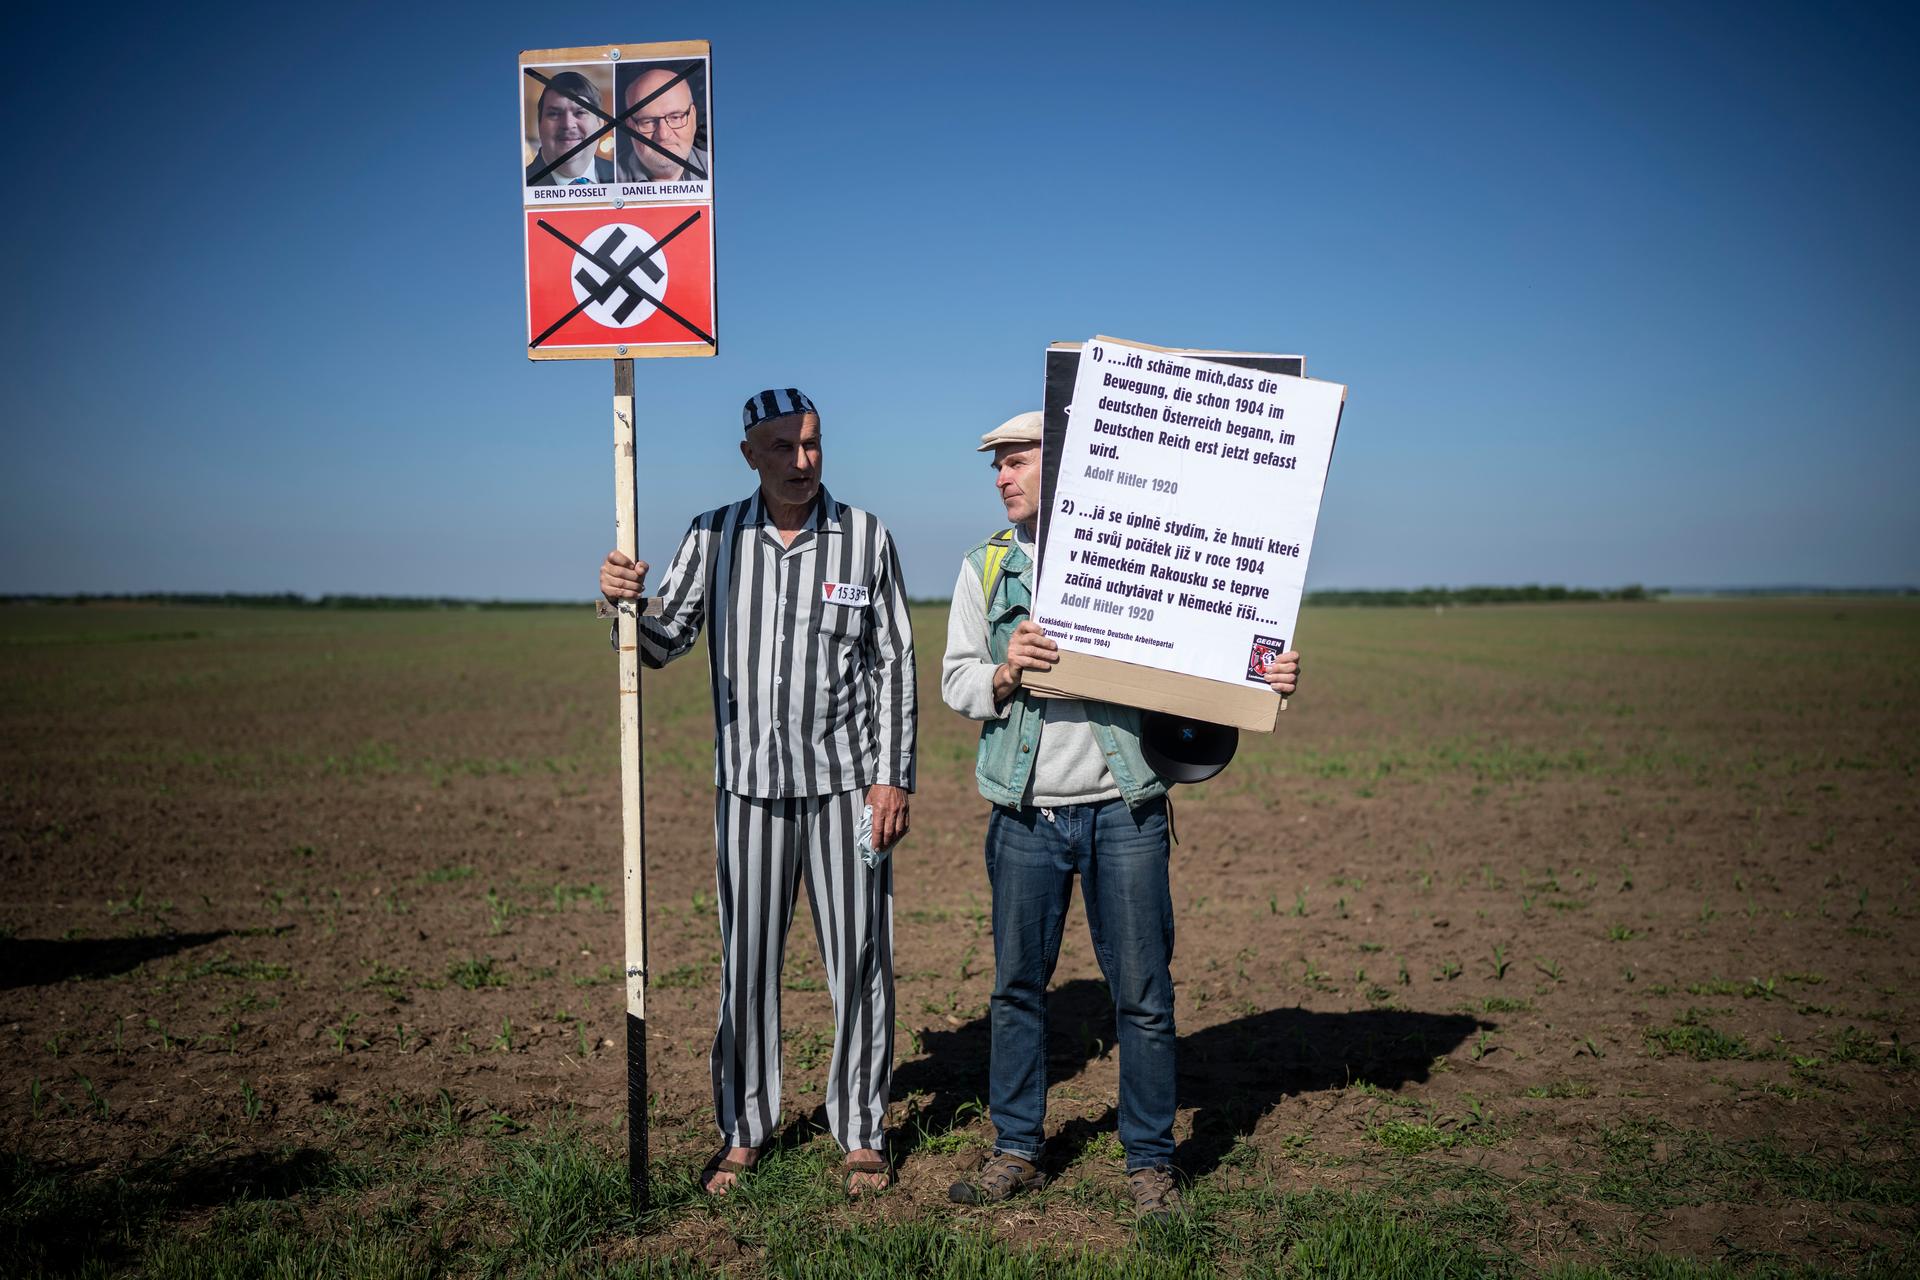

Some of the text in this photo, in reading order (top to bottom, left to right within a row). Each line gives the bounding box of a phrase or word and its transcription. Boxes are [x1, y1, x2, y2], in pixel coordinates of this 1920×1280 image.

[534, 187, 607, 199] BERND POSSELT
[622, 184, 704, 195] DANIEL HERMAN
[1092, 346, 1104, 363] 1)
[1146, 359, 1191, 379] schäme
[1258, 378, 1278, 395] die
[1103, 372, 1285, 420] Bewegung, die schon 1904 im
[1093, 418, 1297, 470] Deutschen Reich erst jetzt gefasst
[1098, 396, 1295, 446] deutschen Österreich begann, im
[1089, 442, 1119, 460] wird.
[1084, 465, 1178, 495] Adolf Hitler 1920
[1060, 499, 1075, 516] 2)
[1108, 511, 1123, 524] se
[1126, 511, 1161, 531] úplně
[1164, 521, 1208, 542] stydím,
[1213, 528, 1227, 544] že
[1231, 532, 1265, 551] hnutí
[1267, 539, 1300, 558] které
[1074, 527, 1265, 575] má svůj počátek již v roce 1904
[1064, 572, 1102, 590] začíná
[1106, 580, 1163, 602] uchytávat
[1167, 593, 1175, 604] v
[1178, 592, 1233, 616] Německé
[1070, 550, 1270, 600] v Německém Rakousku se teprve
[1060, 592, 1154, 622] Adolf Hitler 1920
[1256, 638, 1282, 647] GEGEN
